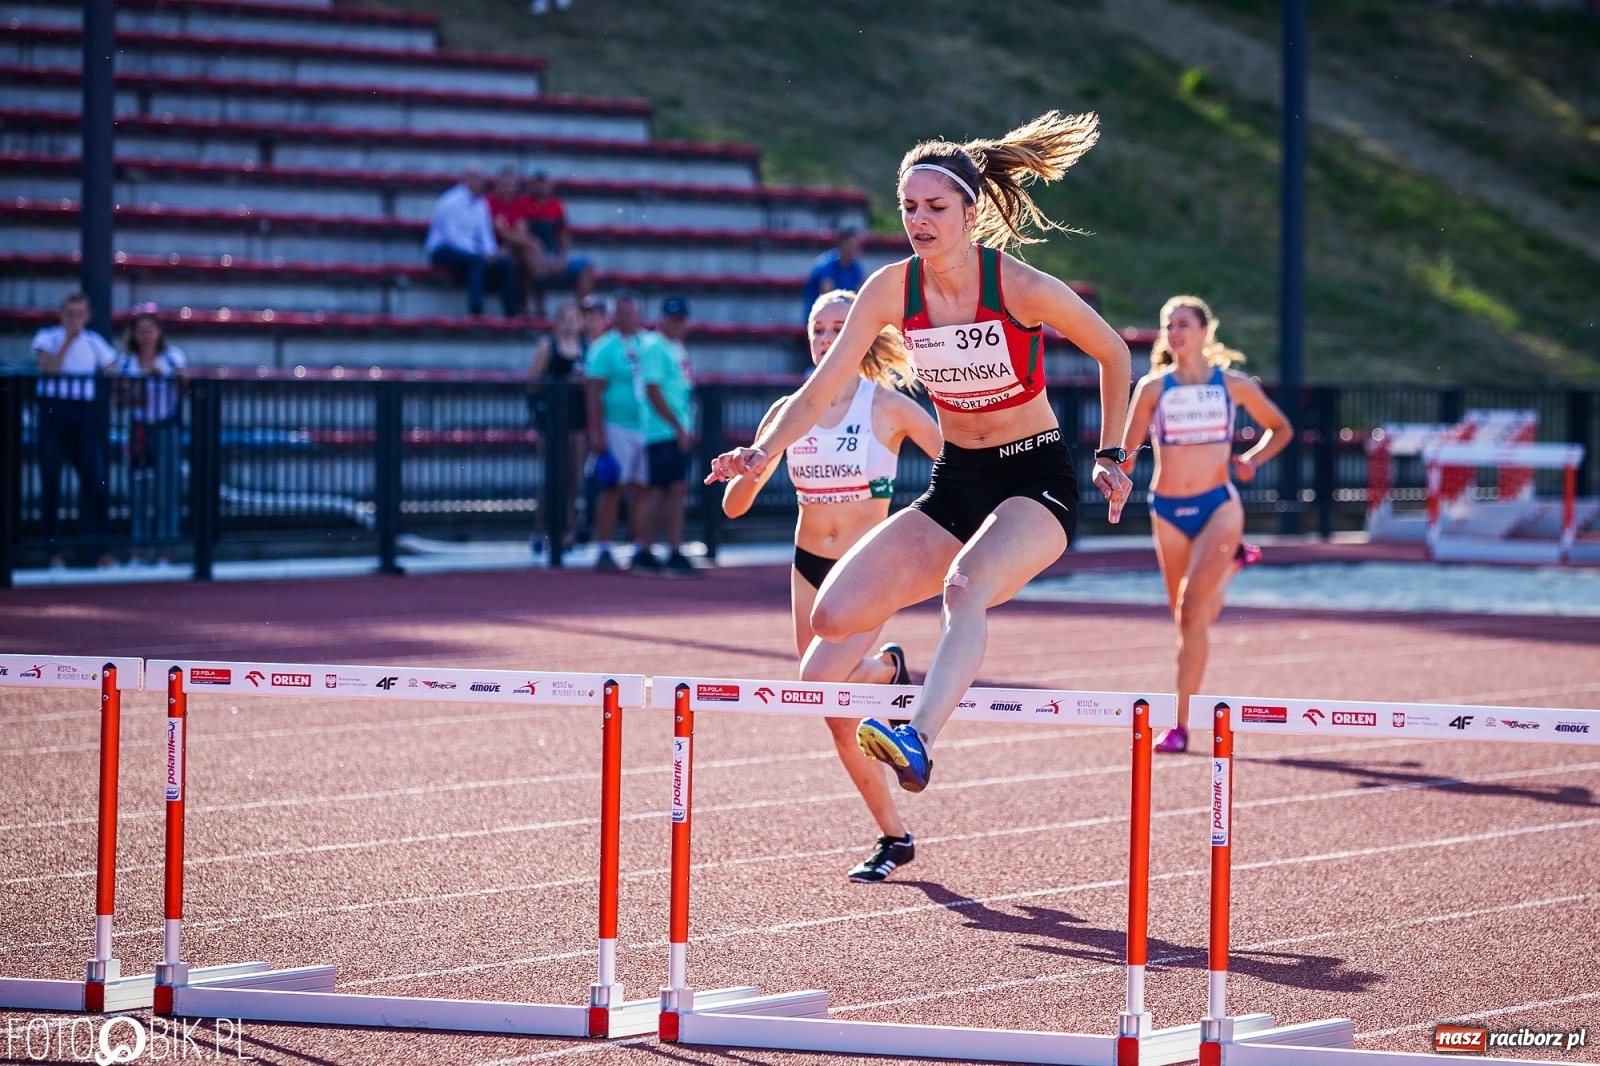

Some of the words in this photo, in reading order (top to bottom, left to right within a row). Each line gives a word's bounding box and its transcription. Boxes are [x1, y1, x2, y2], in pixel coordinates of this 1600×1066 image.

[915, 341, 946, 349] Racibórz
[955, 325, 1000, 350] 396
[836, 436, 858, 452] 78
[999, 438, 1034, 458] NIKE
[1036, 430, 1061, 447] PRO
[273, 675, 310, 686] ORLEN
[376, 676, 399, 690] 4F
[783, 692, 821, 703] ORLEN
[891, 694, 915, 708] 4F
[1333, 713, 1375, 725] ORLEN
[1448, 715, 1475, 730] 4F
[167, 740, 177, 785] polanik
[673, 760, 682, 806] polanik
[1213, 781, 1224, 829] polanik
